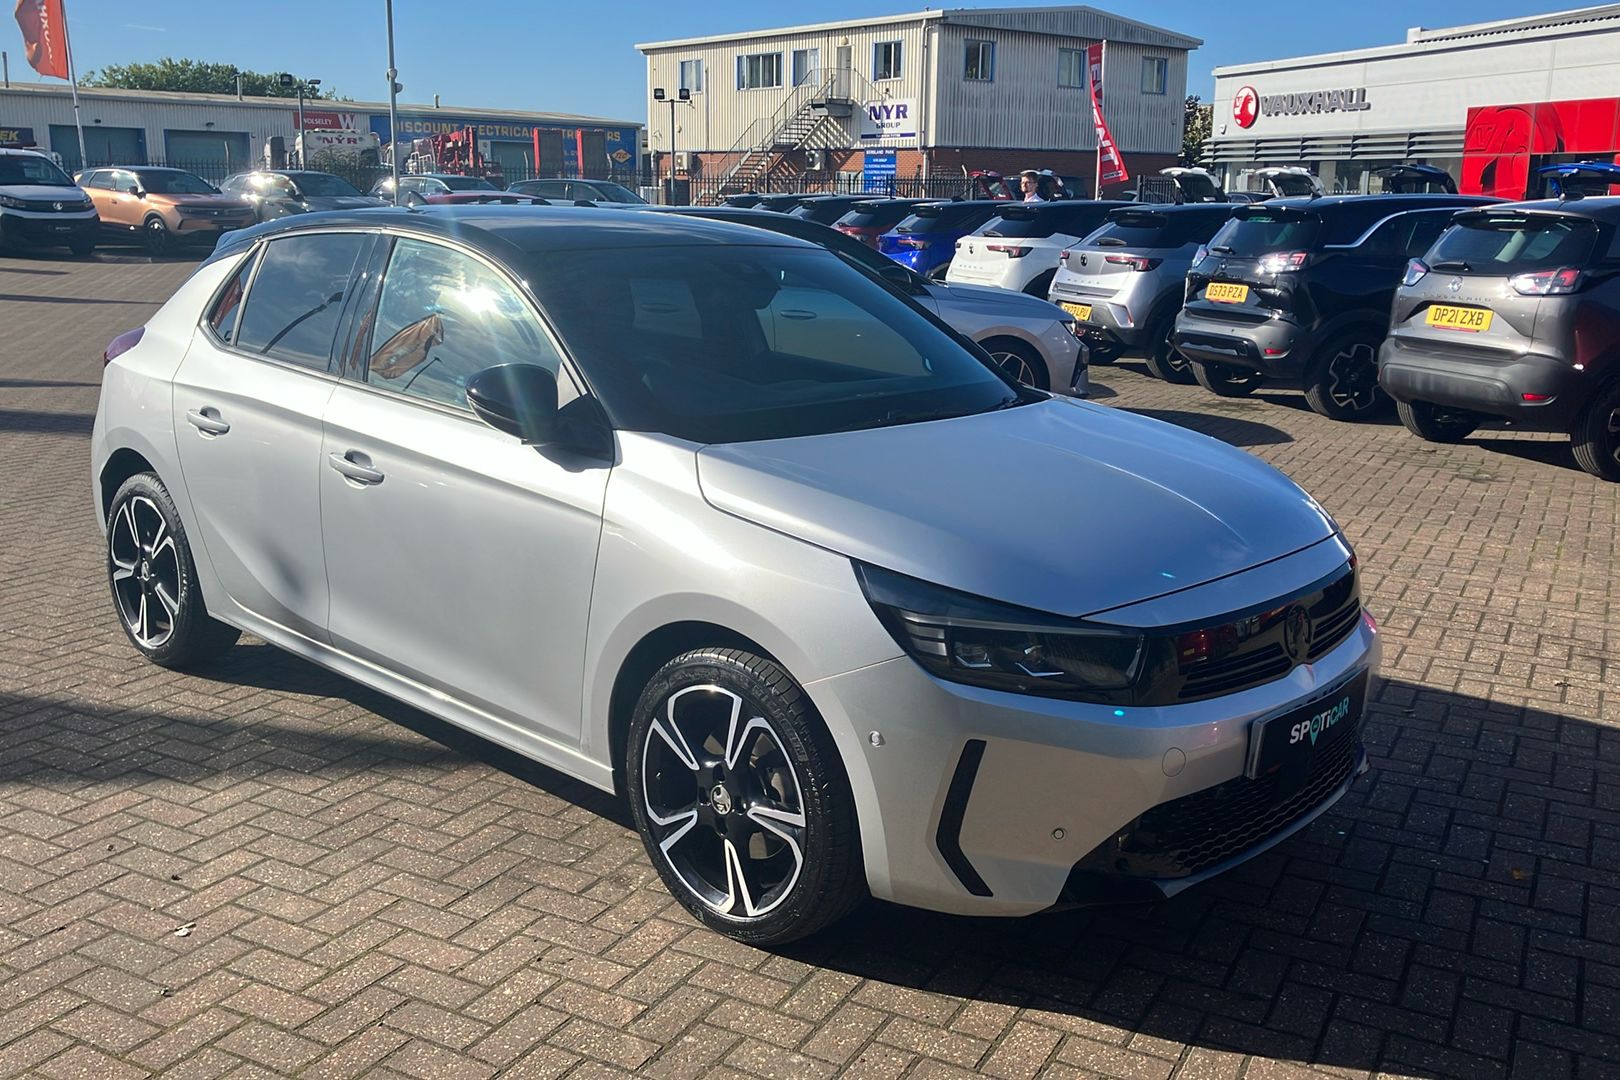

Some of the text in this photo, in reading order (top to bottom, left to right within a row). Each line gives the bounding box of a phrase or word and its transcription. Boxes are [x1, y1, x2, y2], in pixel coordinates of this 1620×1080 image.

[1261, 88, 1370, 116] VAUXHALL
[869, 104, 908, 120] NYR
[396, 121, 459, 134] ISCOUNT
[322, 136, 357, 144] NYR
[1209, 285, 1243, 298] DS73 PZA
[1433, 307, 1484, 326] DP21 ZXB
